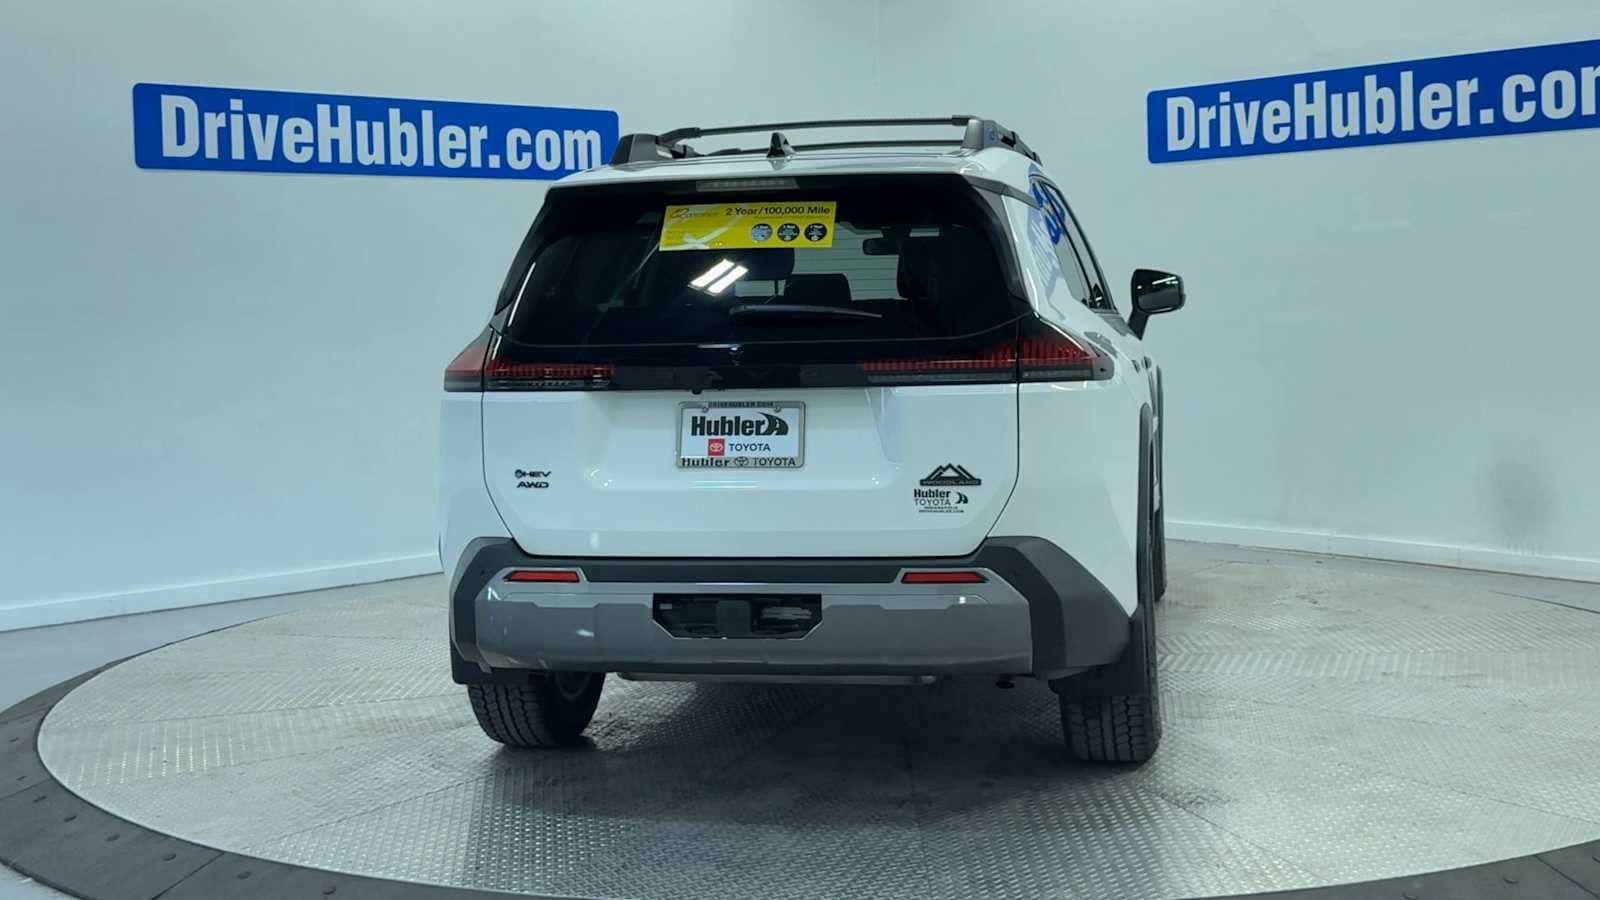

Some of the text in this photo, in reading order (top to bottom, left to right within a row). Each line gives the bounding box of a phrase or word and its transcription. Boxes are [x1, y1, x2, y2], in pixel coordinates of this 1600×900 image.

[160, 94, 602, 170] DriveHubler.com
[725, 207, 733, 216] 2
[807, 205, 831, 215] Mile
[691, 415, 765, 436] Hubler
[729, 443, 771, 452] TOYOTA
[681, 457, 796, 467] Hubler TOYOTA
[914, 489, 950, 498] Hubler
